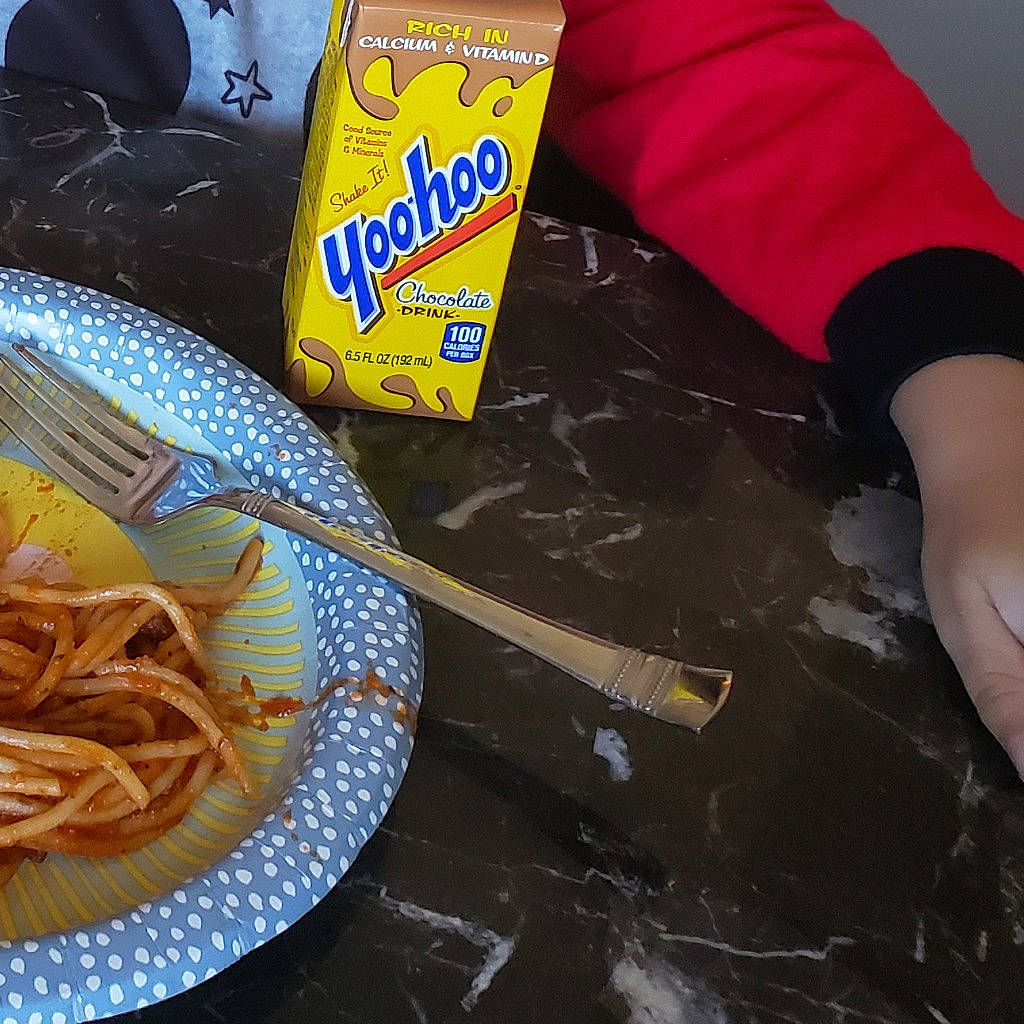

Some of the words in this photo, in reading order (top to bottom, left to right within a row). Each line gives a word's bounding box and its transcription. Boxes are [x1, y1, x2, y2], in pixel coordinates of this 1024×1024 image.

[407, 19, 472, 41] RICH
[483, 28, 509, 44] IN
[358, 35, 437, 52] CALCIUM
[444, 41, 455, 55] &
[366, 127, 392, 136] Source
[344, 135, 353, 143] of
[355, 136, 388, 147] Vitamins
[352, 146, 384, 157] Minerals
[330, 183, 368, 213] Shake
[367, 159, 390, 190] It!
[396, 280, 492, 309] Chocolate
[450, 326, 482, 343] 100
[443, 342, 480, 352] CALORIES
[345, 349, 362, 362] 6.5
[362, 352, 374, 363] FL
[376, 353, 391, 365] OZ
[391, 354, 412, 367] (192
[414, 355, 433, 369] mL)
